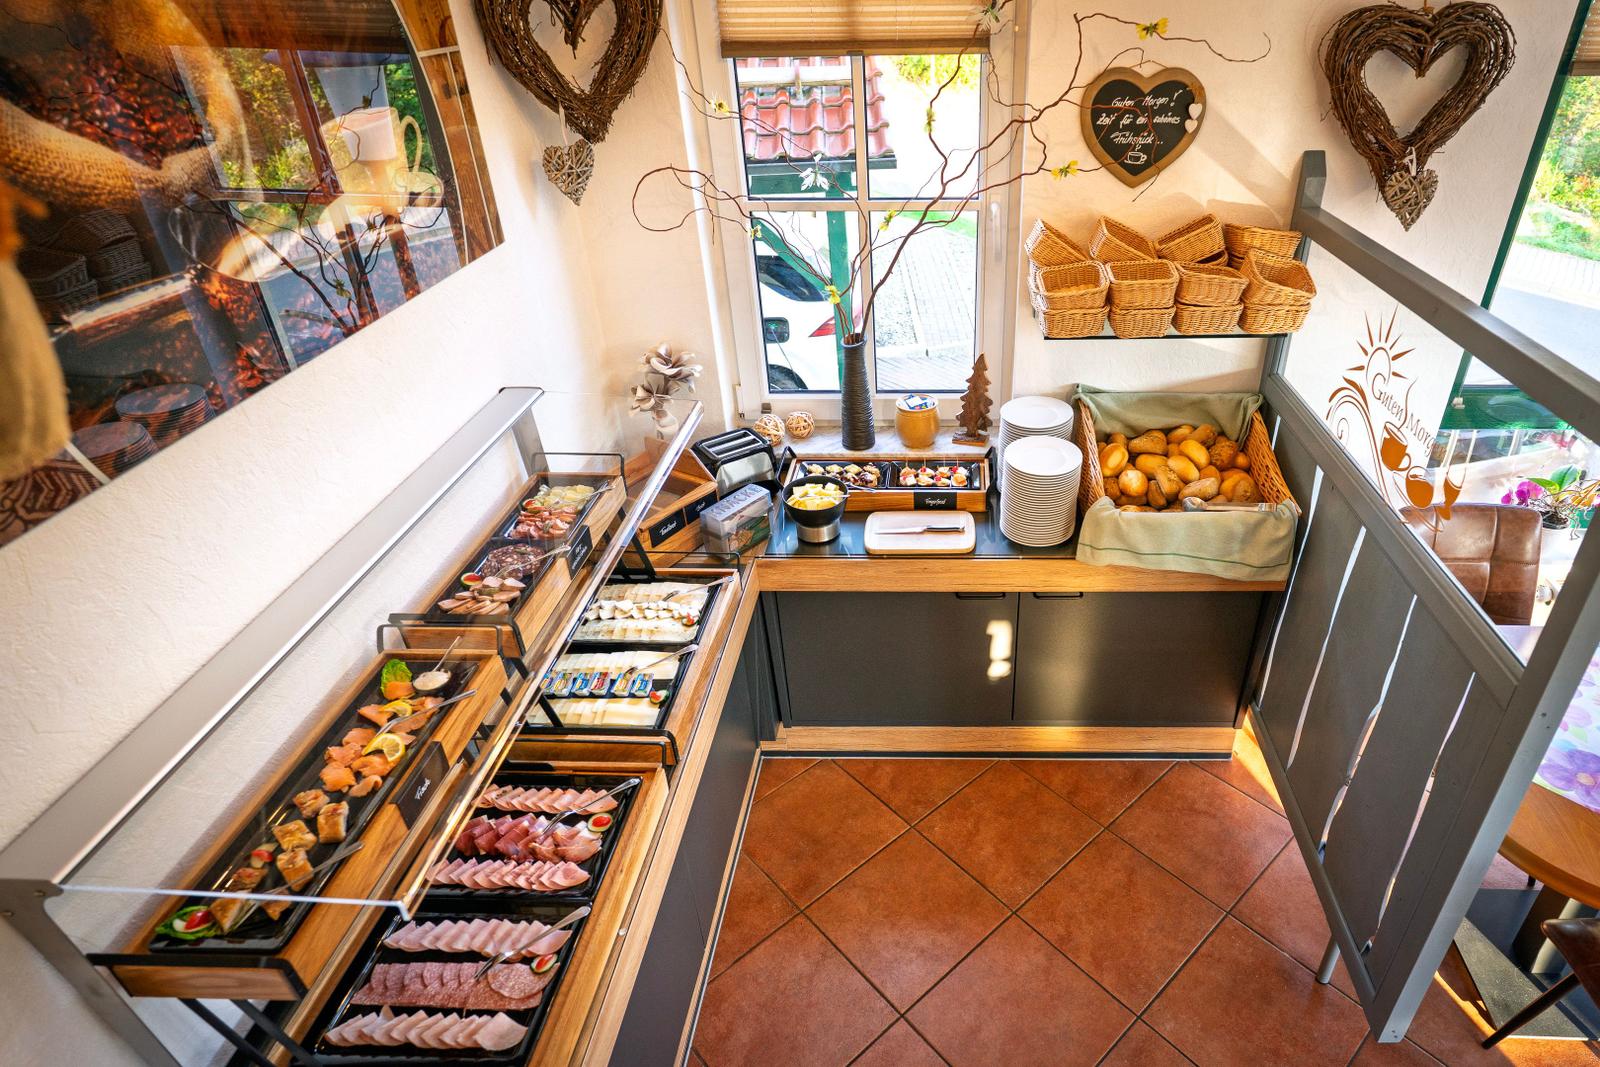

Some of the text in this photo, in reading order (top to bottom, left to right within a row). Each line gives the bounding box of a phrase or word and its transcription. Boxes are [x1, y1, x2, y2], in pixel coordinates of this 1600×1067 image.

[1111, 96, 1135, 107] Guten
[1096, 113, 1117, 125] Zeit
[1120, 114, 1133, 129] für
[1372, 372, 1403, 421] Guten
